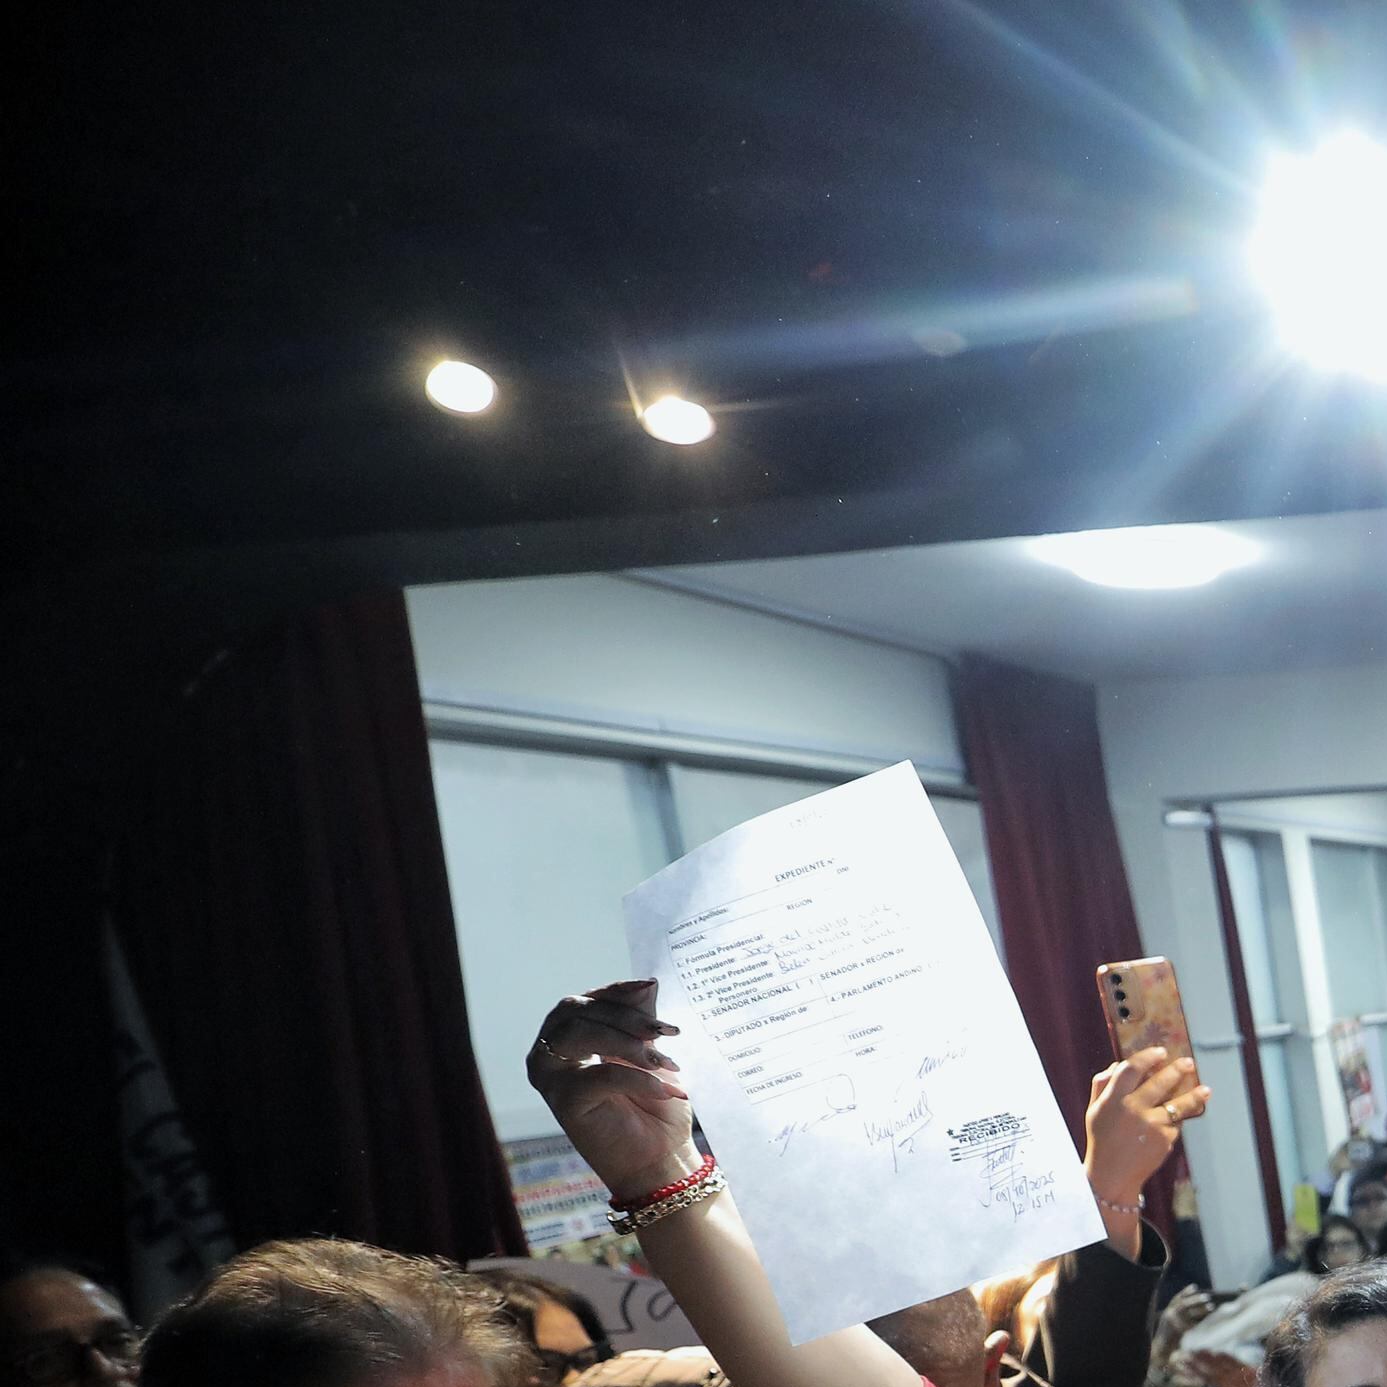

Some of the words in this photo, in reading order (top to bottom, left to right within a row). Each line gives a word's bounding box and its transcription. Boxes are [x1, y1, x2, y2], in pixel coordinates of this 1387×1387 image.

[775, 860, 826, 882] EXPEDIENTE
[820, 962, 858, 980] SENADOR
[866, 952, 894, 964] REGION
[710, 973, 726, 983] Vice
[841, 977, 893, 999] PARLAMENTO
[715, 985, 732, 995] Vice
[712, 1000, 749, 1017] SENADOR
[751, 986, 792, 1002] NACIONAL
[724, 1021, 762, 1038] DIPUTADO
[959, 1123, 1020, 1143] RECIBIDO
